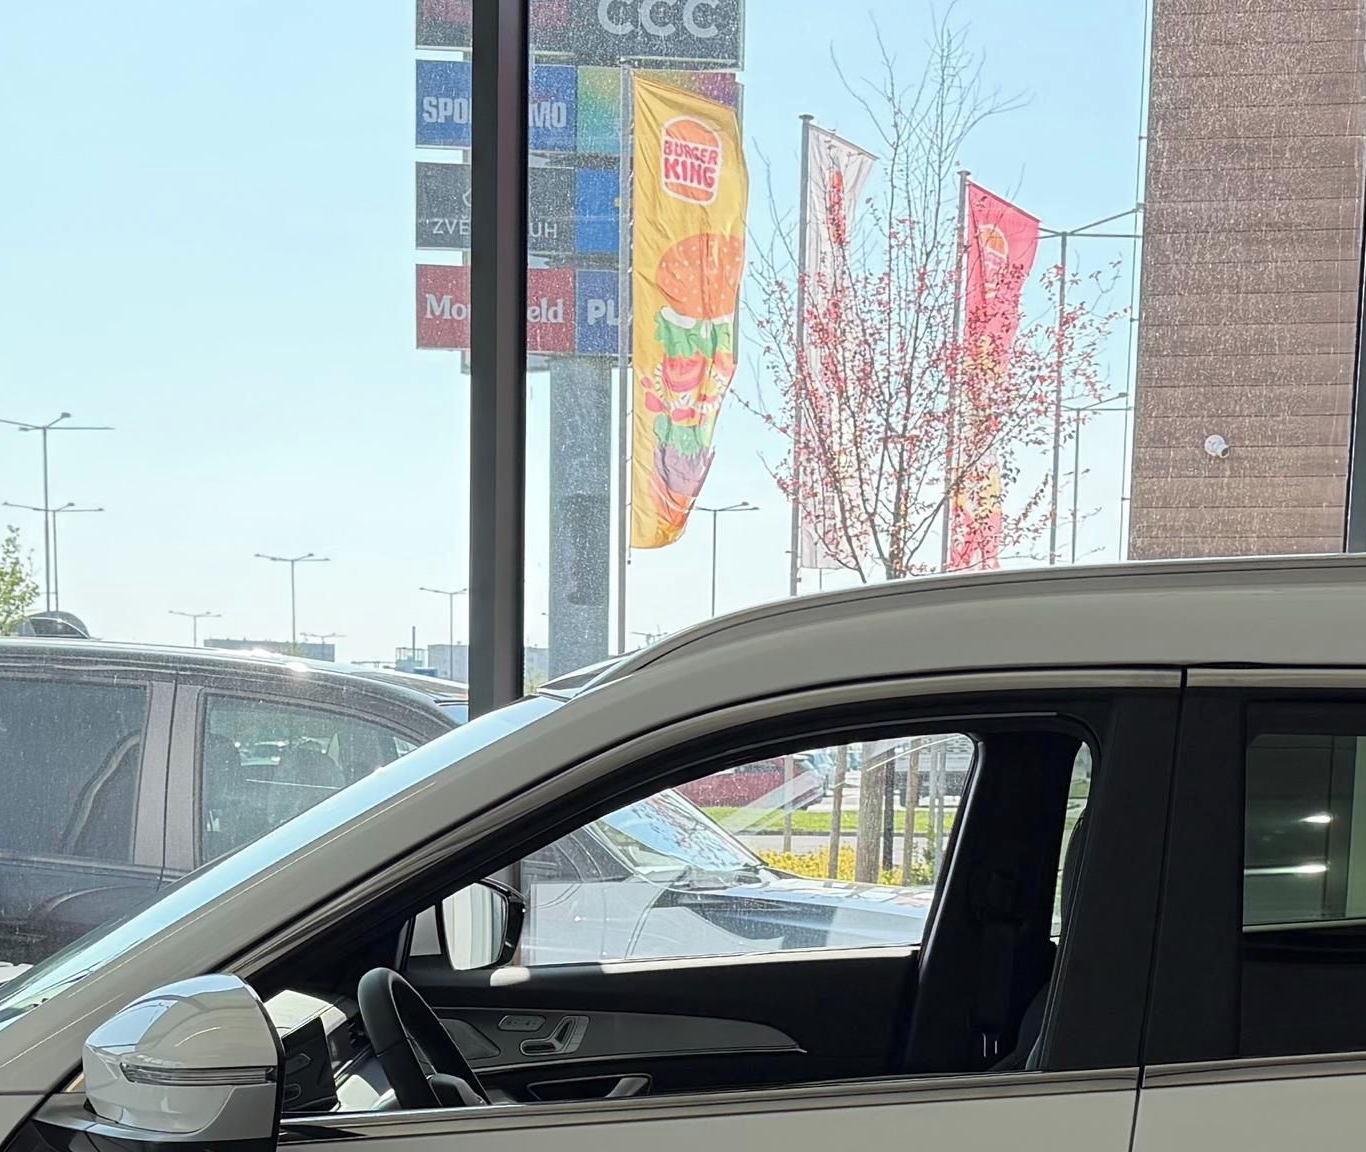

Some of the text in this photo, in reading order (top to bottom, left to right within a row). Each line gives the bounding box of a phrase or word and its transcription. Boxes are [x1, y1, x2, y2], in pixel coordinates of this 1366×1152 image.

[422, 96, 567, 128] SPOMO
[663, 139, 719, 165] BURGER
[663, 157, 716, 189] KING
